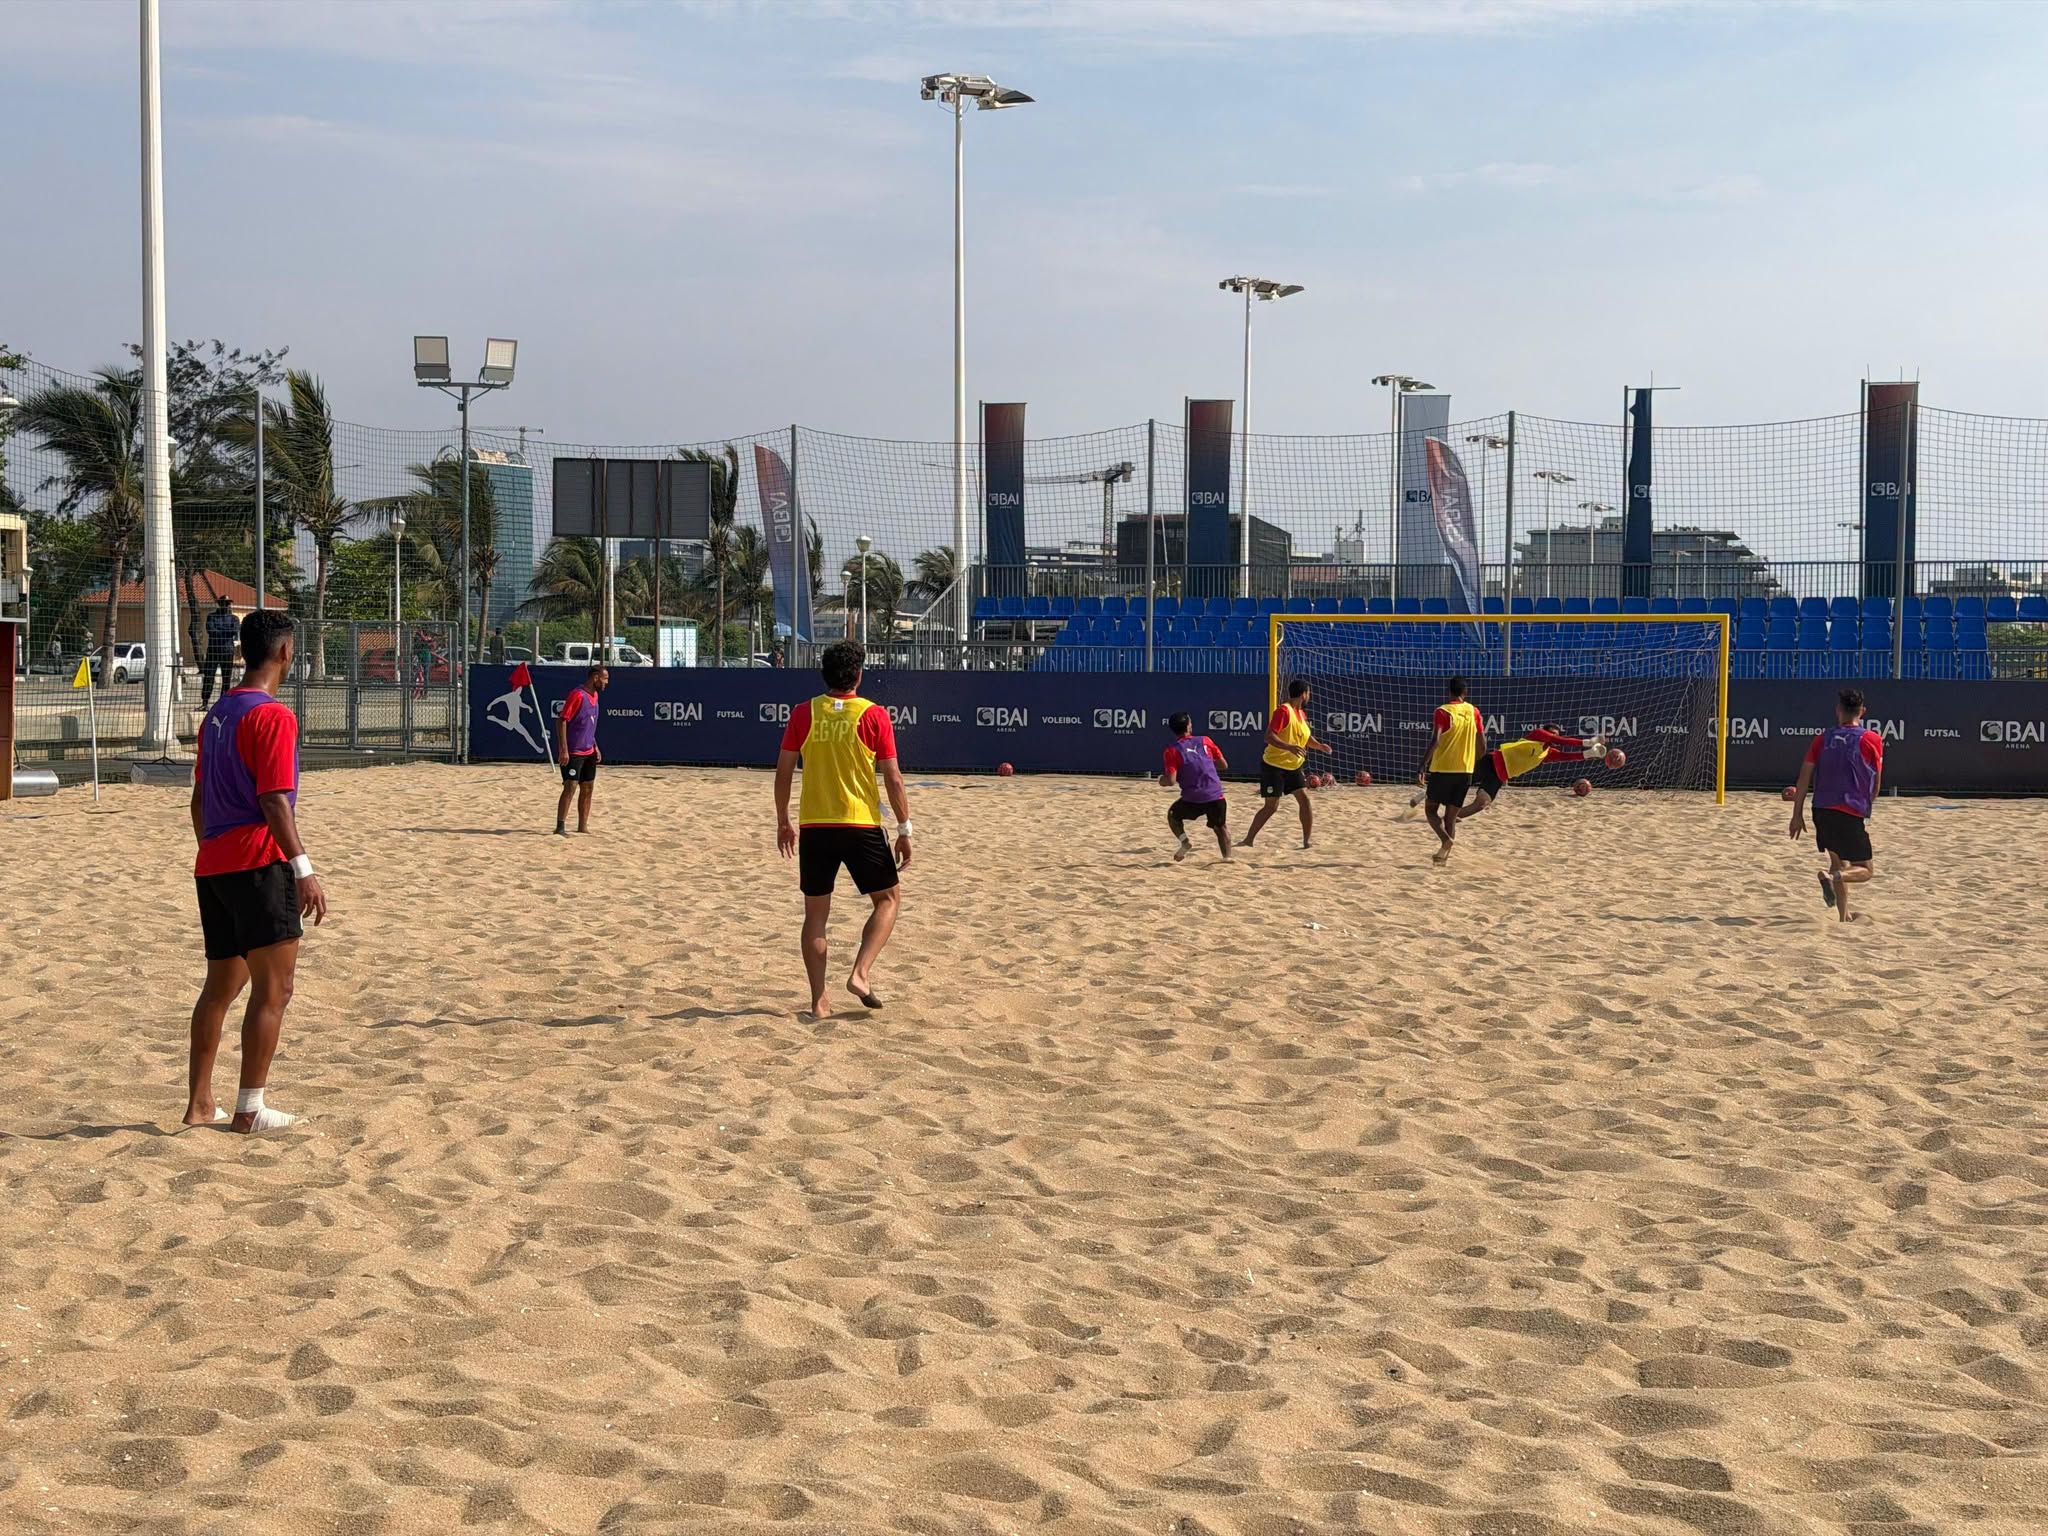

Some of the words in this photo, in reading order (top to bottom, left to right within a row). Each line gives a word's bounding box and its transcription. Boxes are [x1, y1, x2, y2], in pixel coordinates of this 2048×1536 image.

[999, 492, 1020, 505] BAI
[1204, 491, 1225, 505] BAI
[606, 708, 645, 717] VOLEIBOL
[672, 702, 703, 721] BAI
[716, 711, 745, 719] FUTSAL
[932, 714, 962, 723] FUTSAL
[996, 707, 1028, 727] BAI
[1042, 715, 1083, 725] VOLEIBOL
[1113, 709, 1146, 729] BAI
[1229, 710, 1263, 731] BAI
[812, 720, 858, 744] EGYPT
[1348, 713, 1382, 733] BAI
[1399, 721, 1431, 730] FUTSAL
[1484, 714, 1505, 735] AI
[1601, 716, 1637, 737] BAI
[1655, 724, 1690, 734] FUTSAL
[1731, 717, 1769, 739] BAI
[2005, 721, 2045, 743] BAI
[1924, 728, 1961, 738] FUTSAL
